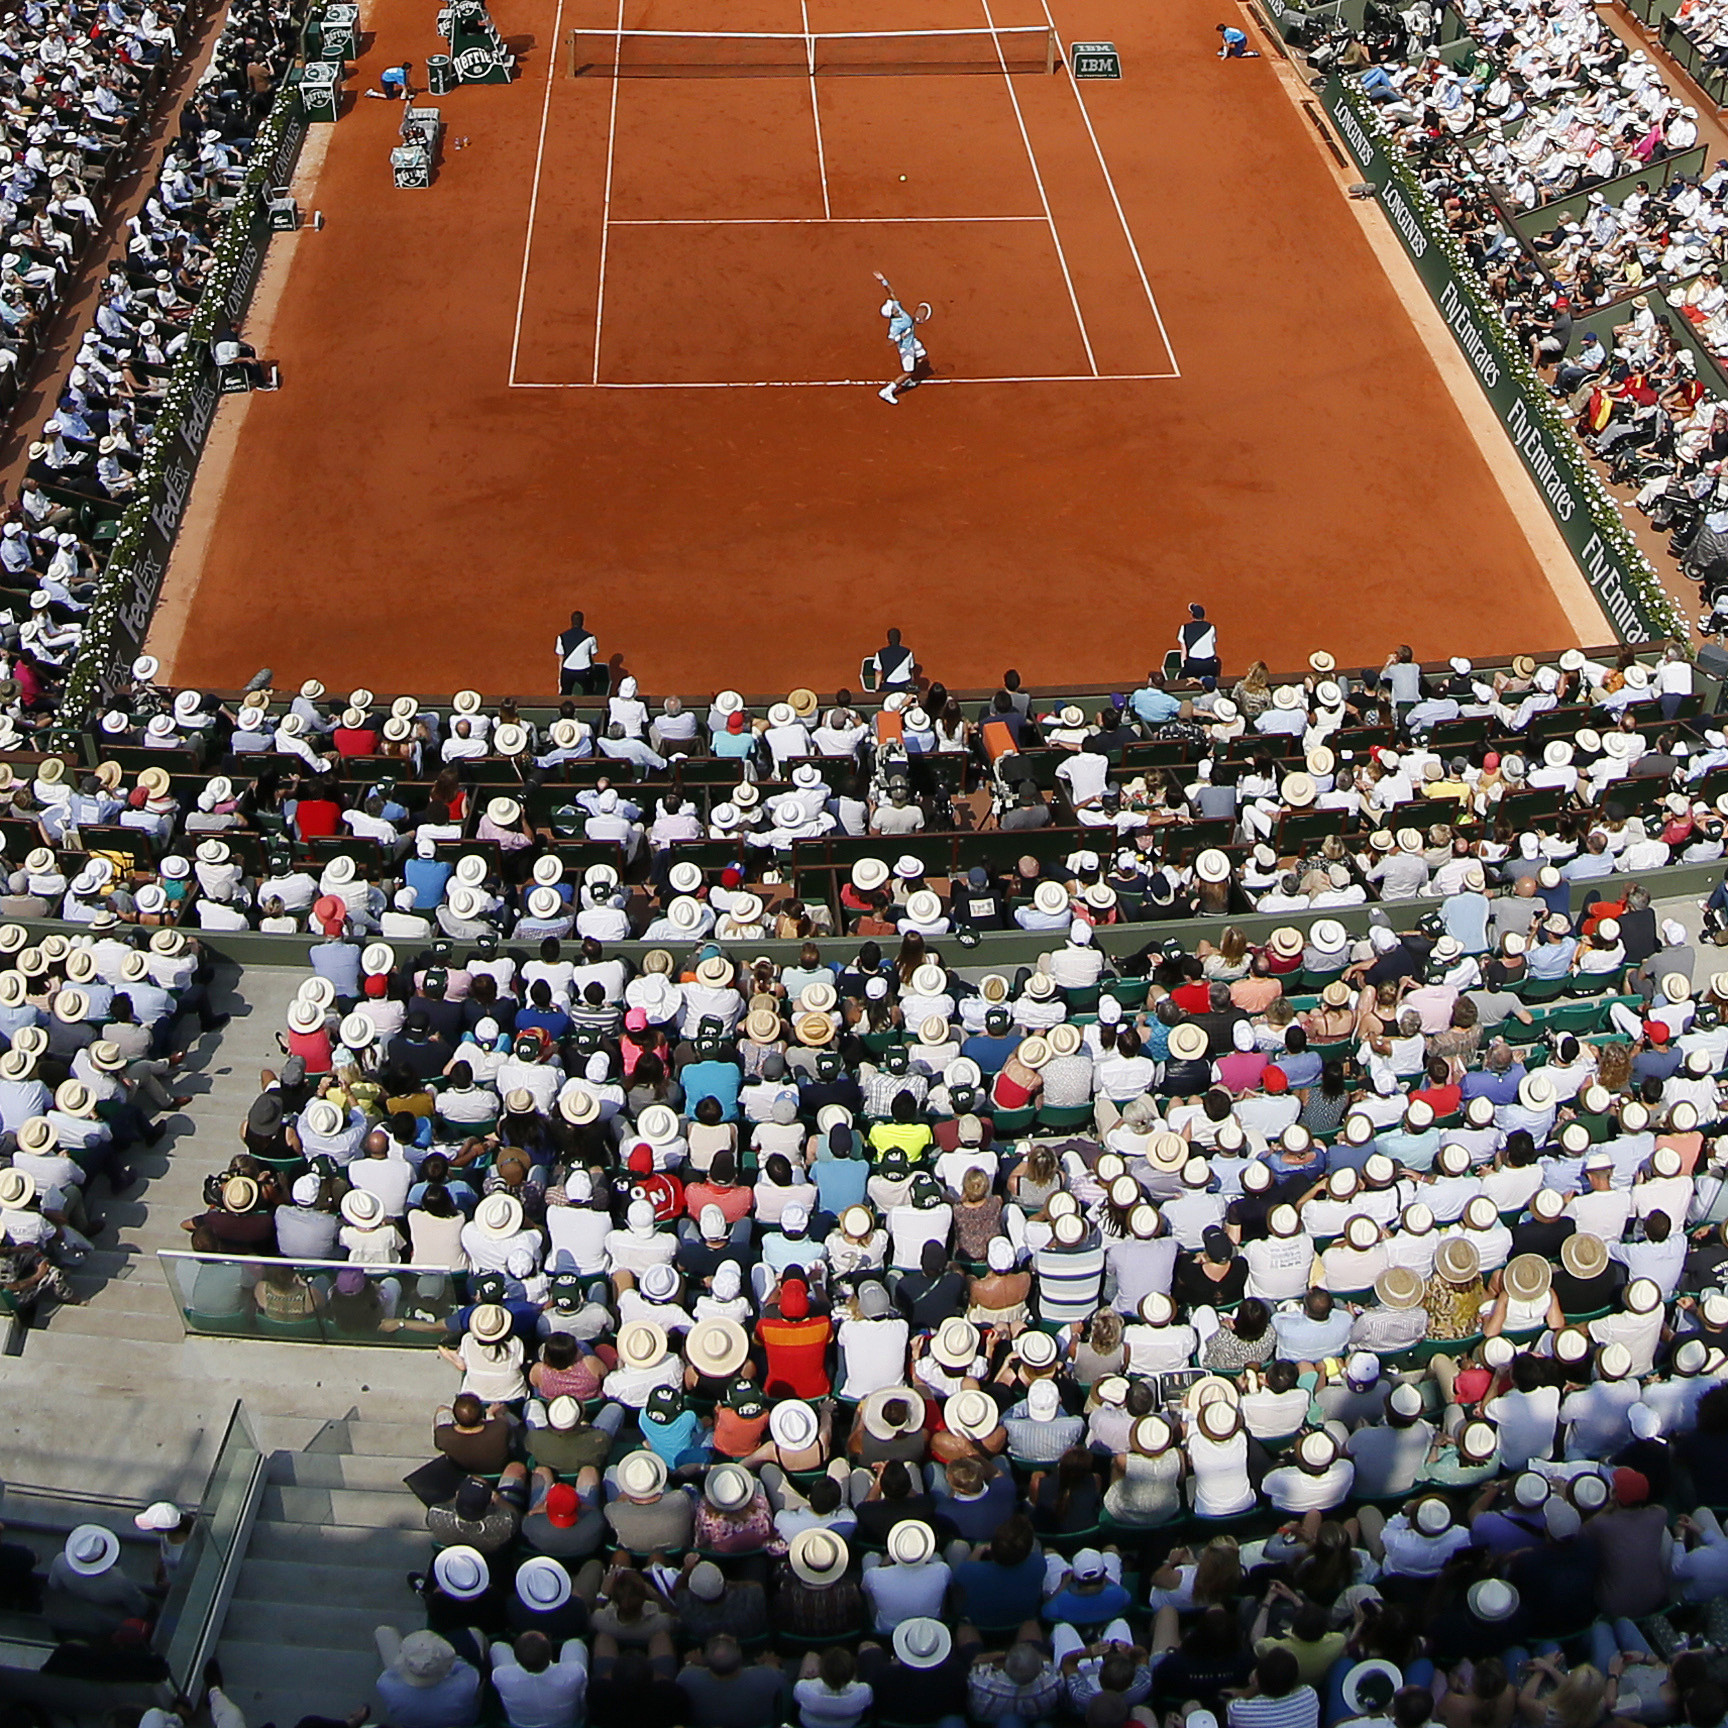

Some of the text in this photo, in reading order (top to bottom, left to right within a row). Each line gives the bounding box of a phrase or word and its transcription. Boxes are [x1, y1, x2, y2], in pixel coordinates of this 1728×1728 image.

[1081, 59, 1113, 72] IBM
[1333, 97, 1374, 166] LONGINES
[1382, 180, 1428, 258] LONGINES
[180, 377, 216, 456] FedEx
[152, 456, 190, 542] FedEx
[119, 549, 161, 644] FedEx
[1600, 566, 1650, 644] Emira
